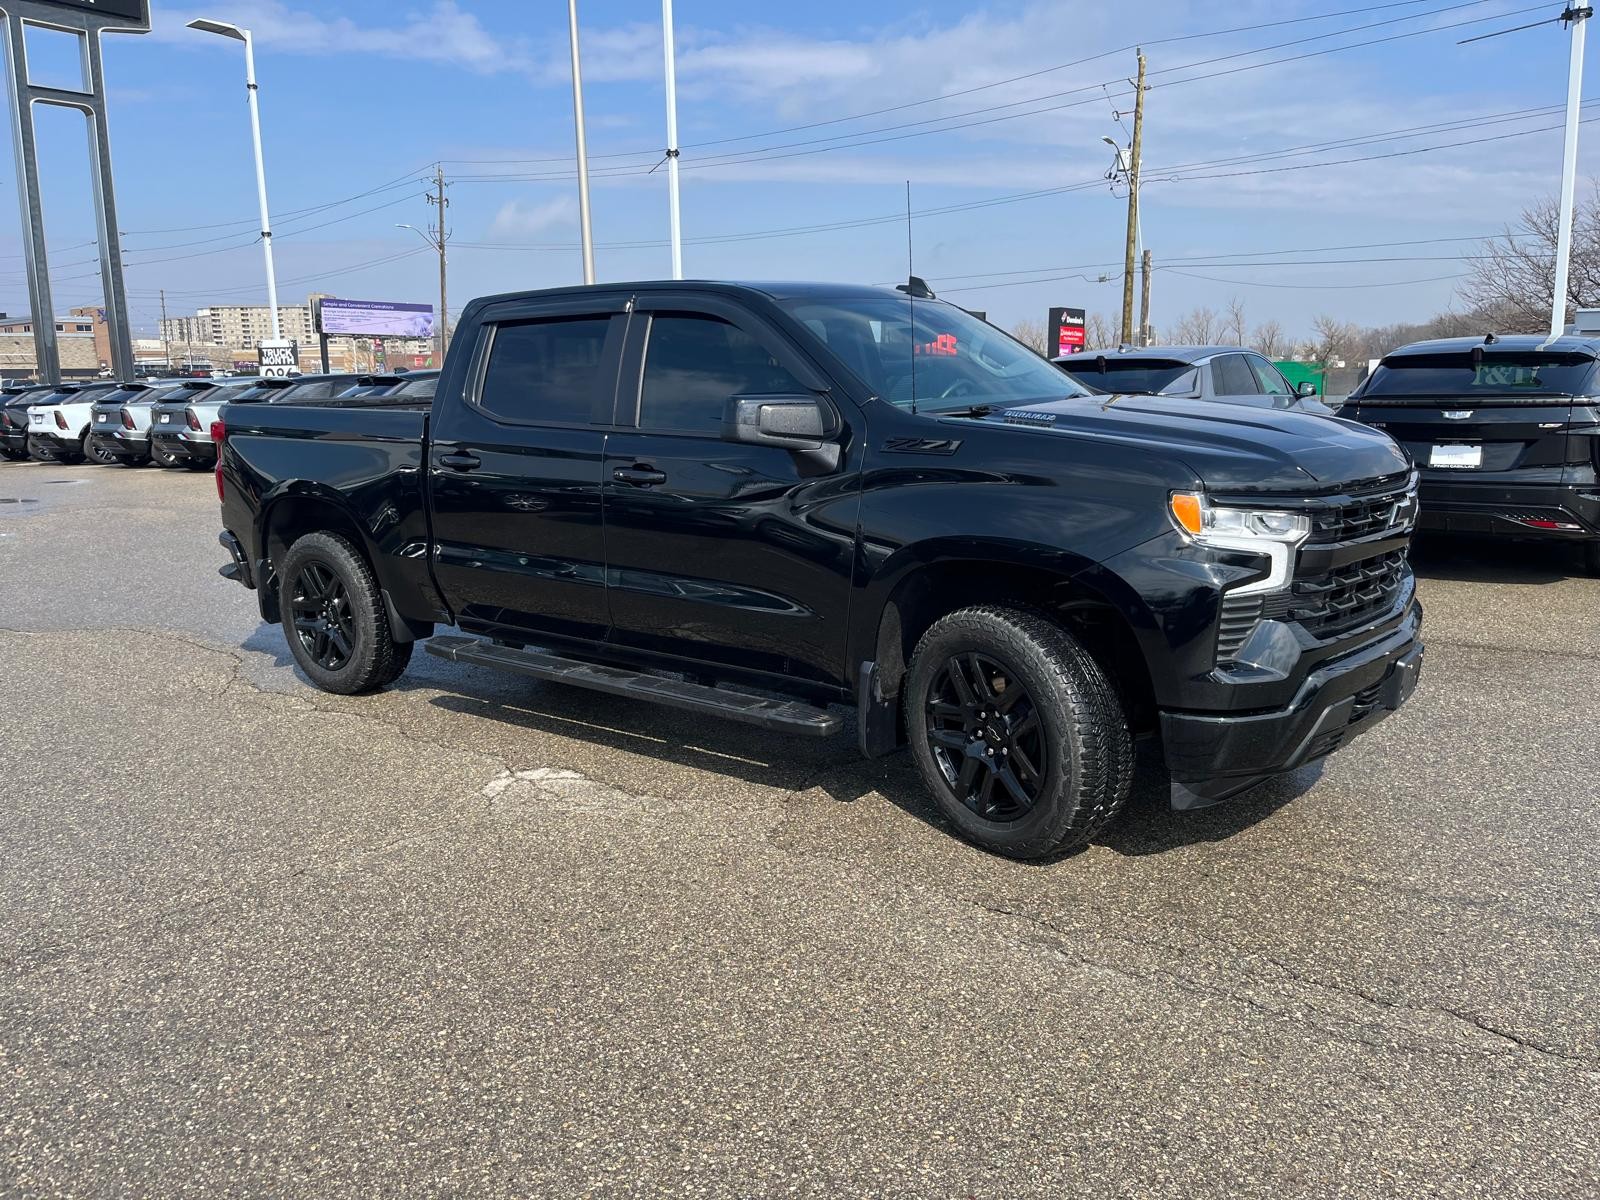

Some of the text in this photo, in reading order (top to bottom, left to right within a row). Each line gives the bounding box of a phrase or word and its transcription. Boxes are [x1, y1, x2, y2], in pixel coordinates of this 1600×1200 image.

[261, 348, 292, 357] TRUCK
[262, 355, 295, 365] MONTH
[1004, 410, 1056, 421] DURAMAX
[881, 438, 962, 456] Z71
